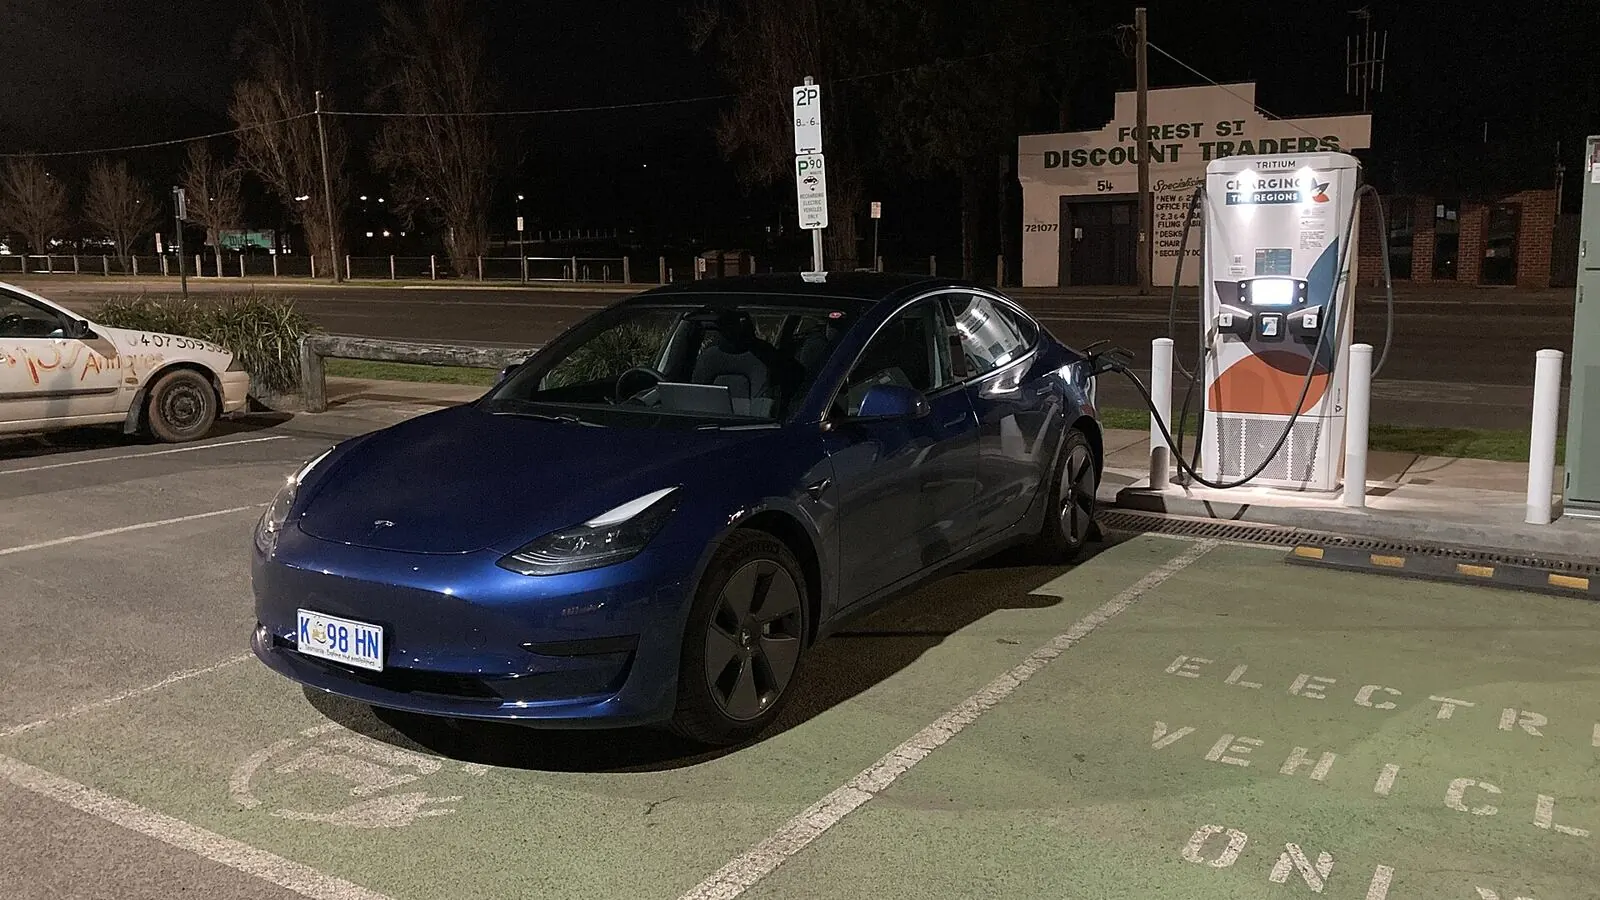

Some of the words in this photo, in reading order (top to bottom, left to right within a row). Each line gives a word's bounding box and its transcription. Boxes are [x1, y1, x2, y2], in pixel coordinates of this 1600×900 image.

[796, 89, 818, 106] 2P
[1044, 141, 1183, 169] DISCOUNT
[1199, 135, 1340, 161] TRADERS
[1256, 160, 1296, 169] TRITIUM
[1097, 180, 1114, 192] 54
[1226, 178, 1301, 191] CHRGIN
[1160, 194, 1176, 202] NEW
[1231, 194, 1249, 203] TH
[1254, 193, 1298, 202] REGIONS
[1156, 203, 1181, 212] OFFICE
[1024, 223, 1058, 233] 721077
[1157, 220, 1181, 229] FILING
[1160, 230, 1183, 238] DESKS
